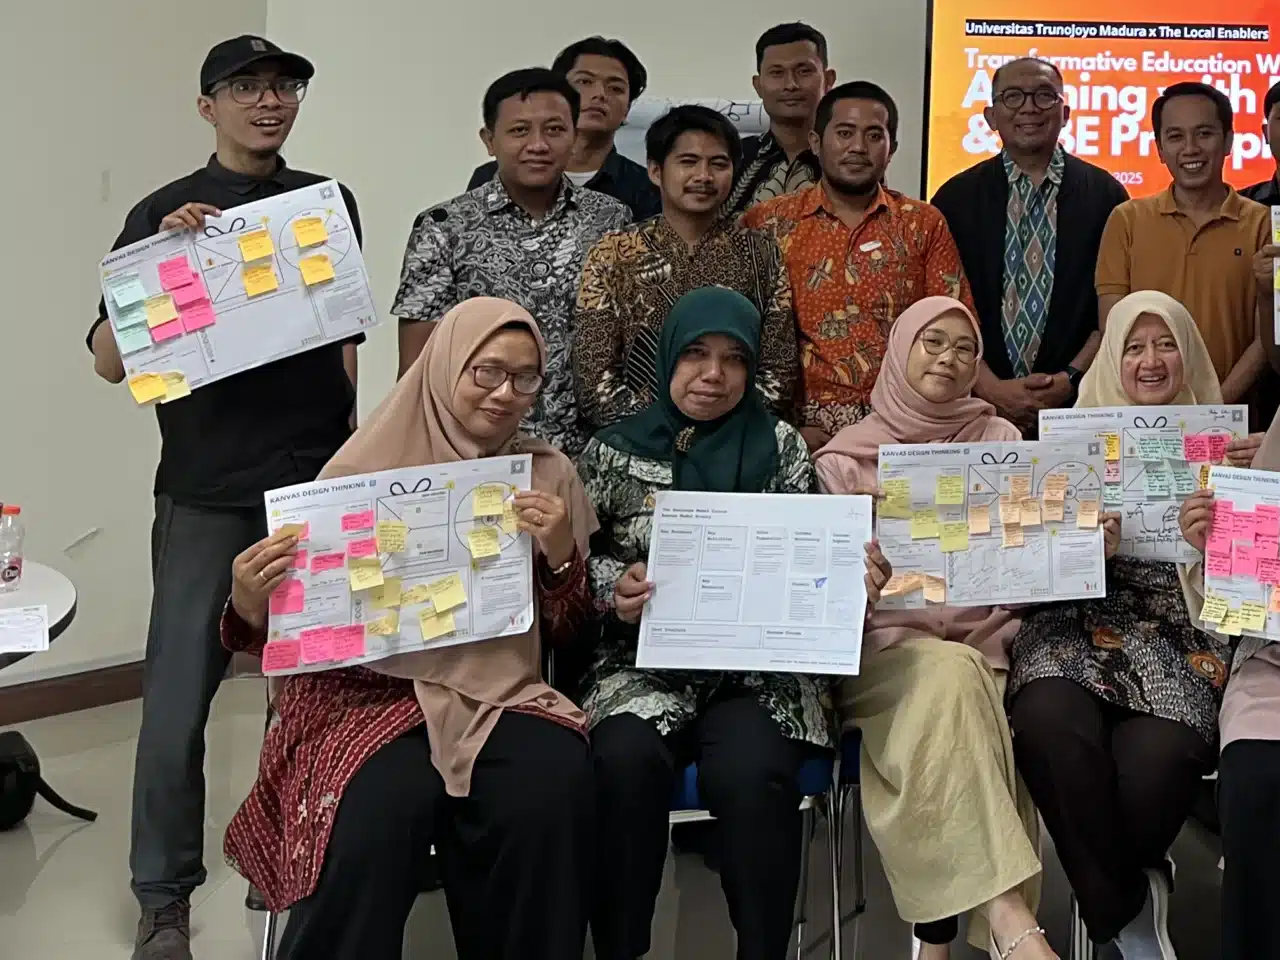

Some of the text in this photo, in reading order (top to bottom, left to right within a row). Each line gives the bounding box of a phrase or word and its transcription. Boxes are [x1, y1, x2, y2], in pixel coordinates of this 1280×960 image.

[966, 22, 1269, 40] Universitas Trunojoyo Madura x The Local Enablers
[1142, 50, 1251, 74] Education
[270, 481, 366, 504] KANVAS DESIGN THINKING
